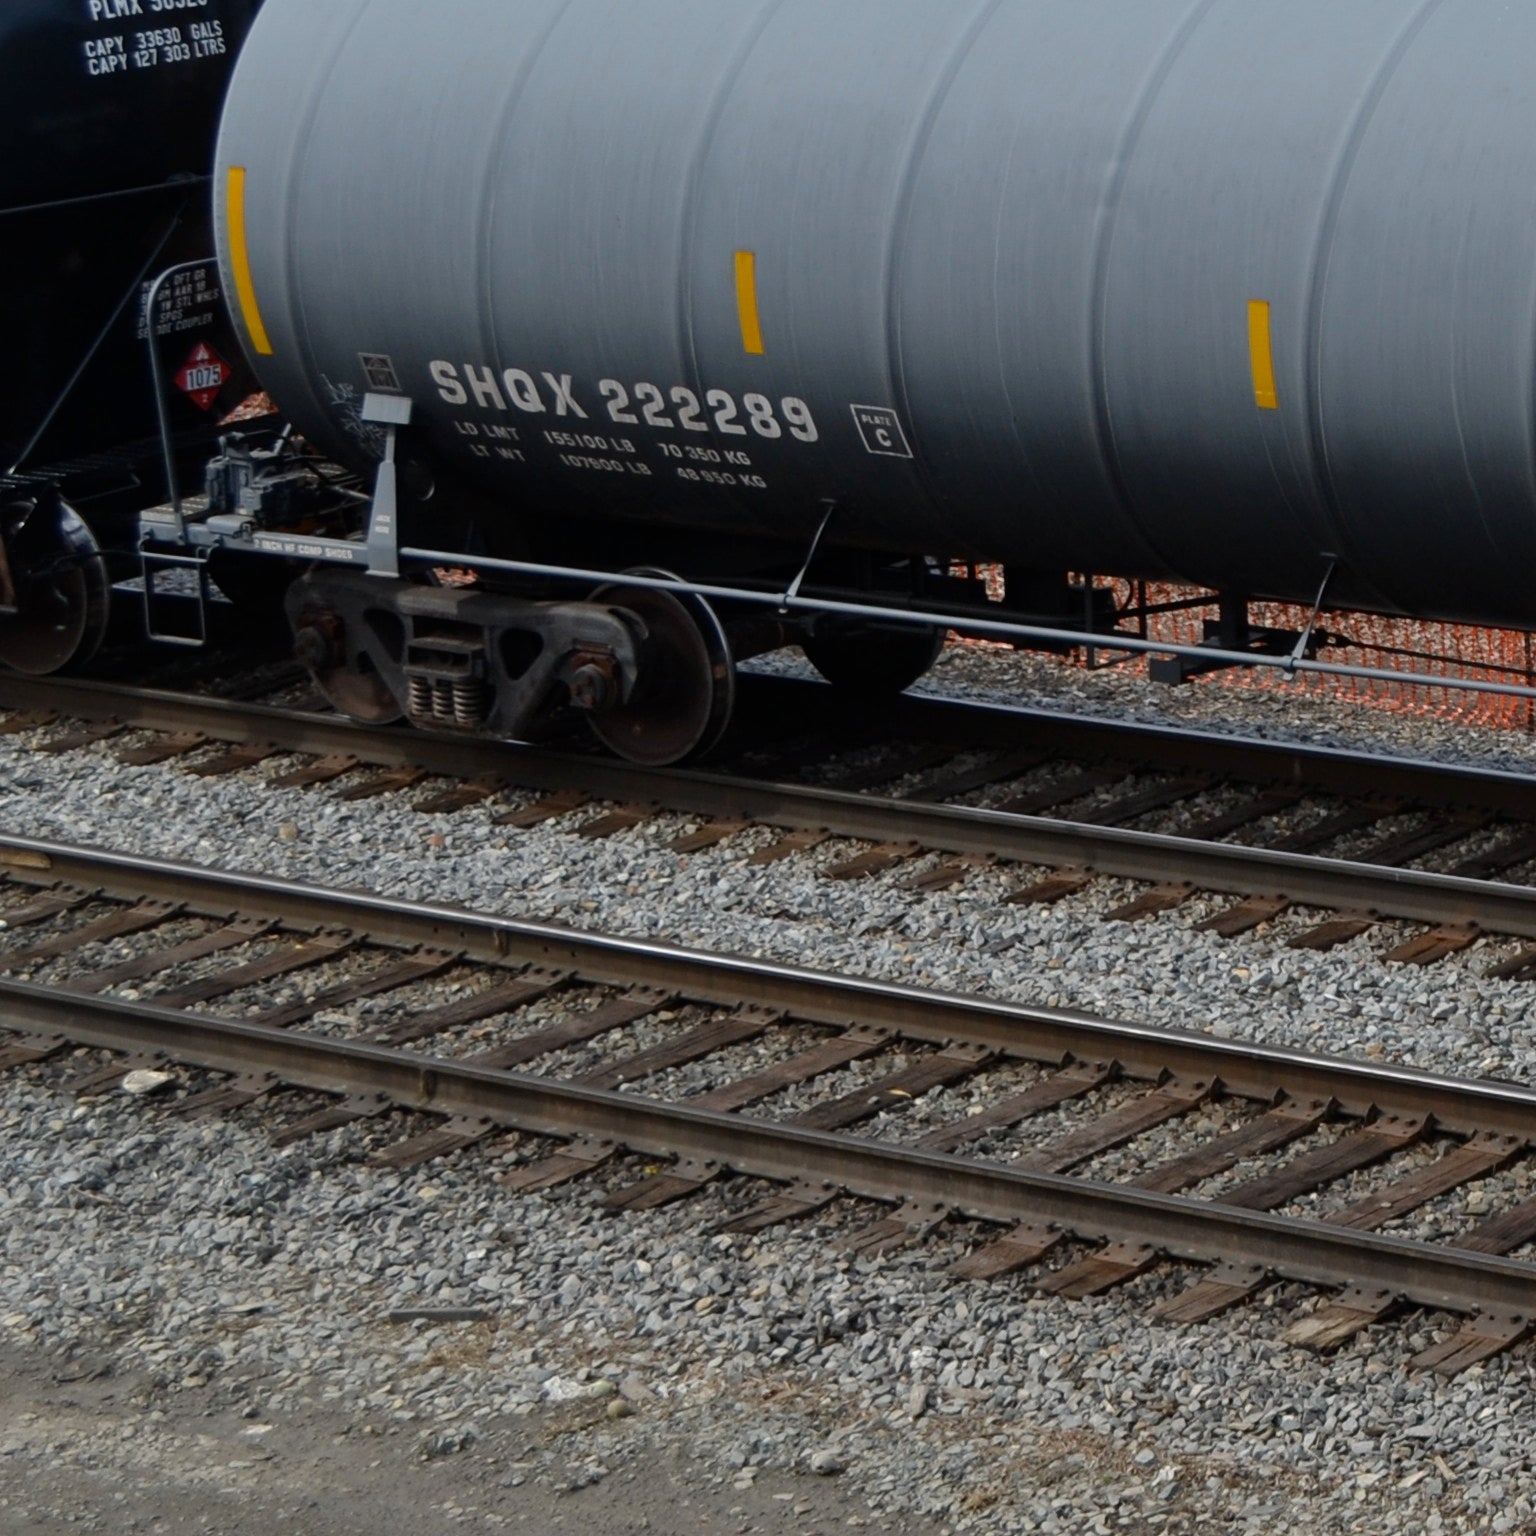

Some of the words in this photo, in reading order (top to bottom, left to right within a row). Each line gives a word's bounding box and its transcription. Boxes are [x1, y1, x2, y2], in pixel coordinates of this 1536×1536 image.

[84, 35, 124, 58] CAPY
[135, 26, 182, 49] 33630
[190, 19, 223, 40] GALS
[88, 52, 128, 76] CAPY
[134, 48, 157, 68] 127
[163, 42, 191, 63] 303
[194, 37, 226, 58] LTRS
[187, 365, 221, 391] 1075
[429, 360, 589, 419] SHQX
[599, 378, 819, 443] 222289
[861, 413, 892, 427] PLATE
[454, 420, 478, 436] LD
[483, 421, 520, 441] LMT
[543, 429, 606, 450] 155100
[610, 436, 636, 453] LB
[657, 442, 682, 458] 70
[685, 445, 721, 463] 350
[723, 450, 752, 466] KG
[876, 429, 892, 447] C
[469, 444, 491, 457] LT
[497, 446, 526, 462] WT
[624, 461, 652, 476] LB
[676, 466, 700, 481] 48
[739, 474, 767, 489] KG
[298, 545, 323, 557] COMP
[325, 547, 354, 560] SHOES
